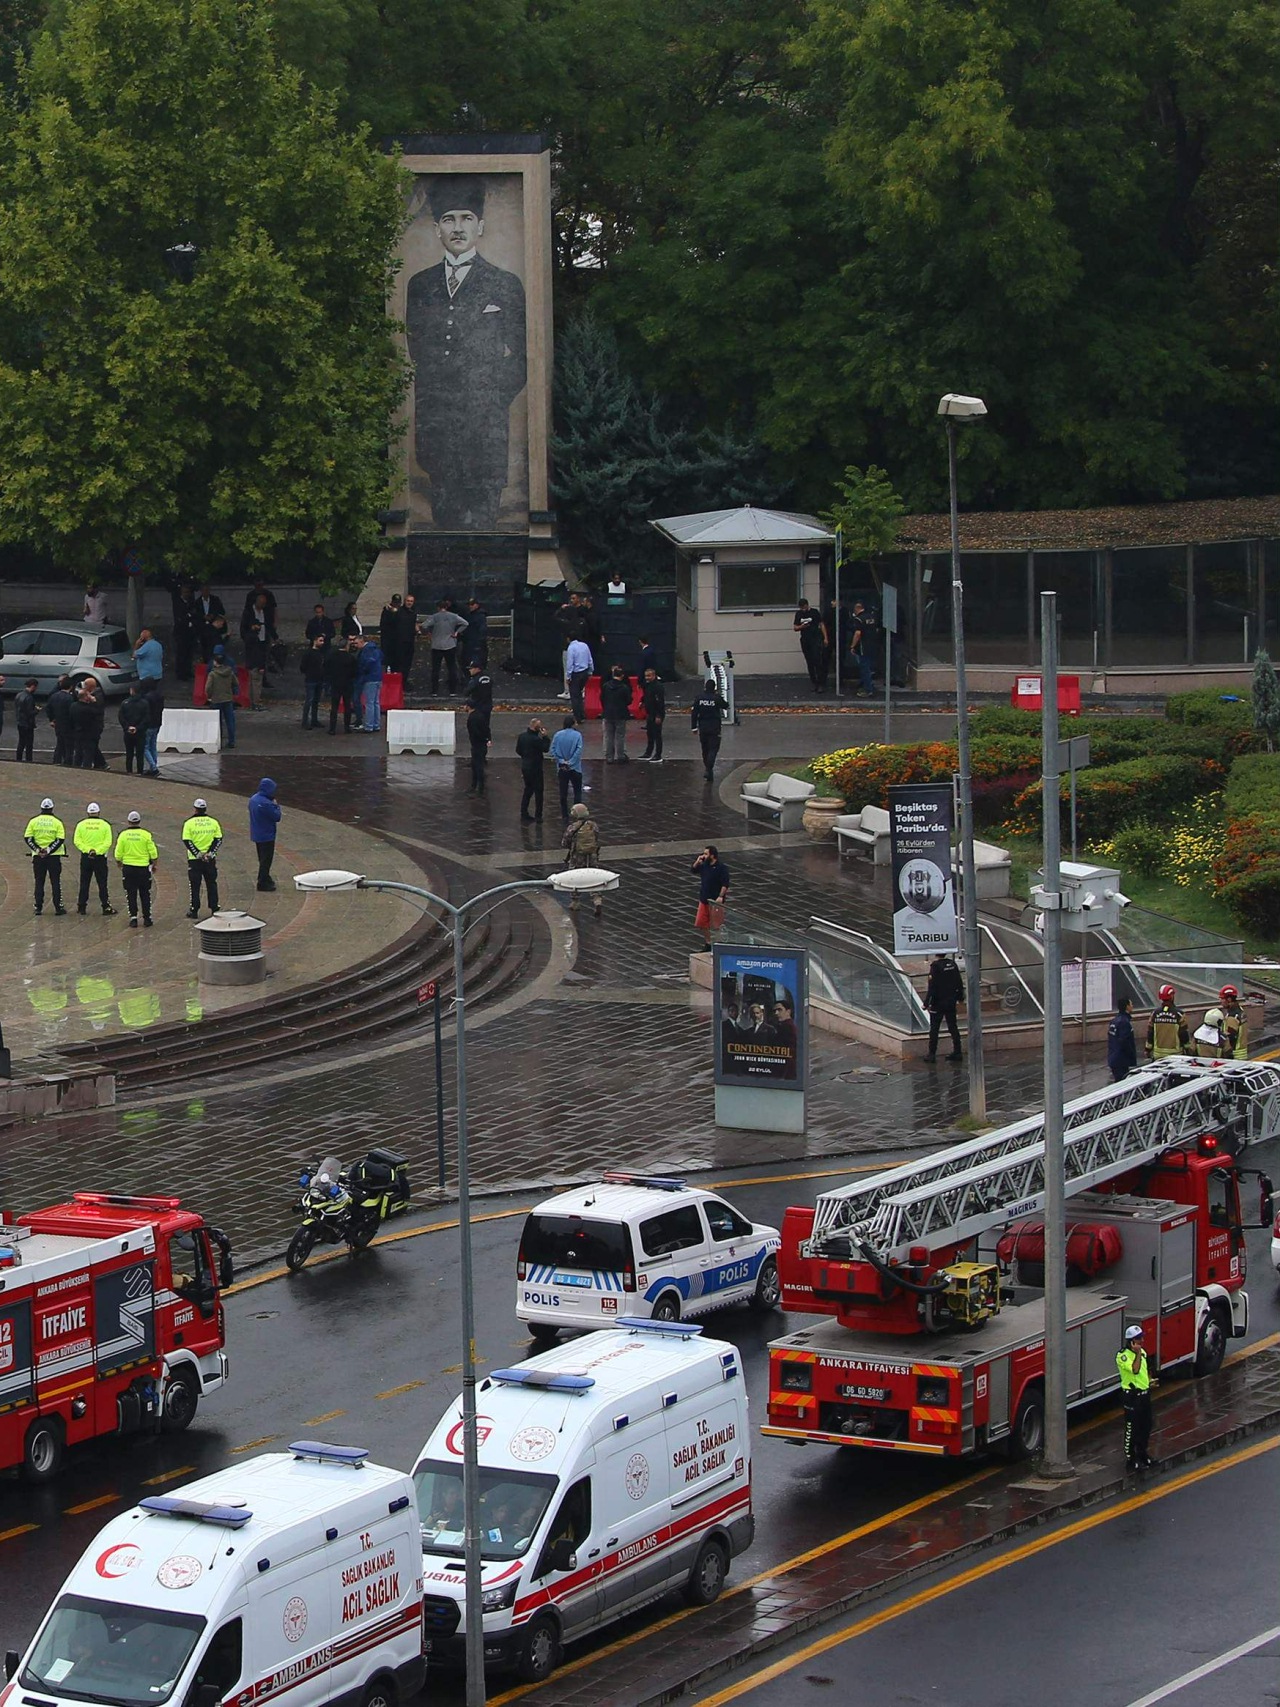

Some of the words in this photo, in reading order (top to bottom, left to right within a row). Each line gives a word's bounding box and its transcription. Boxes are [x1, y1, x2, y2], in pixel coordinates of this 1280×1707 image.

[895, 803, 938, 813] Beşiktaş
[895, 814, 926, 822] Token
[896, 823, 948, 833] Paribu'da.
[736, 960, 761, 968] amazon
[762, 961, 784, 969] prime
[727, 1043, 791, 1058] CONTINENTAL
[1008, 1199, 1037, 1218] MAGIRUS
[37, 1283, 59, 1298] ANKARA
[603, 1299, 616, 1308] 112
[42, 1306, 87, 1340] İTFAİYE
[819, 1358, 864, 1371] ANKARA
[673, 1443, 698, 1468] SAĞLIK
[700, 1423, 735, 1455] BAKANLIĞI
[702, 1450, 726, 1473] SAĞLIK
[617, 1534, 657, 1564] AMBULANS
[341, 1565, 364, 1588] SAĞLIK
[364, 1547, 396, 1578] BAKANLIĞI
[365, 1572, 400, 1613] SAĞLIK
[271, 1645, 333, 1690] AMBULANS
